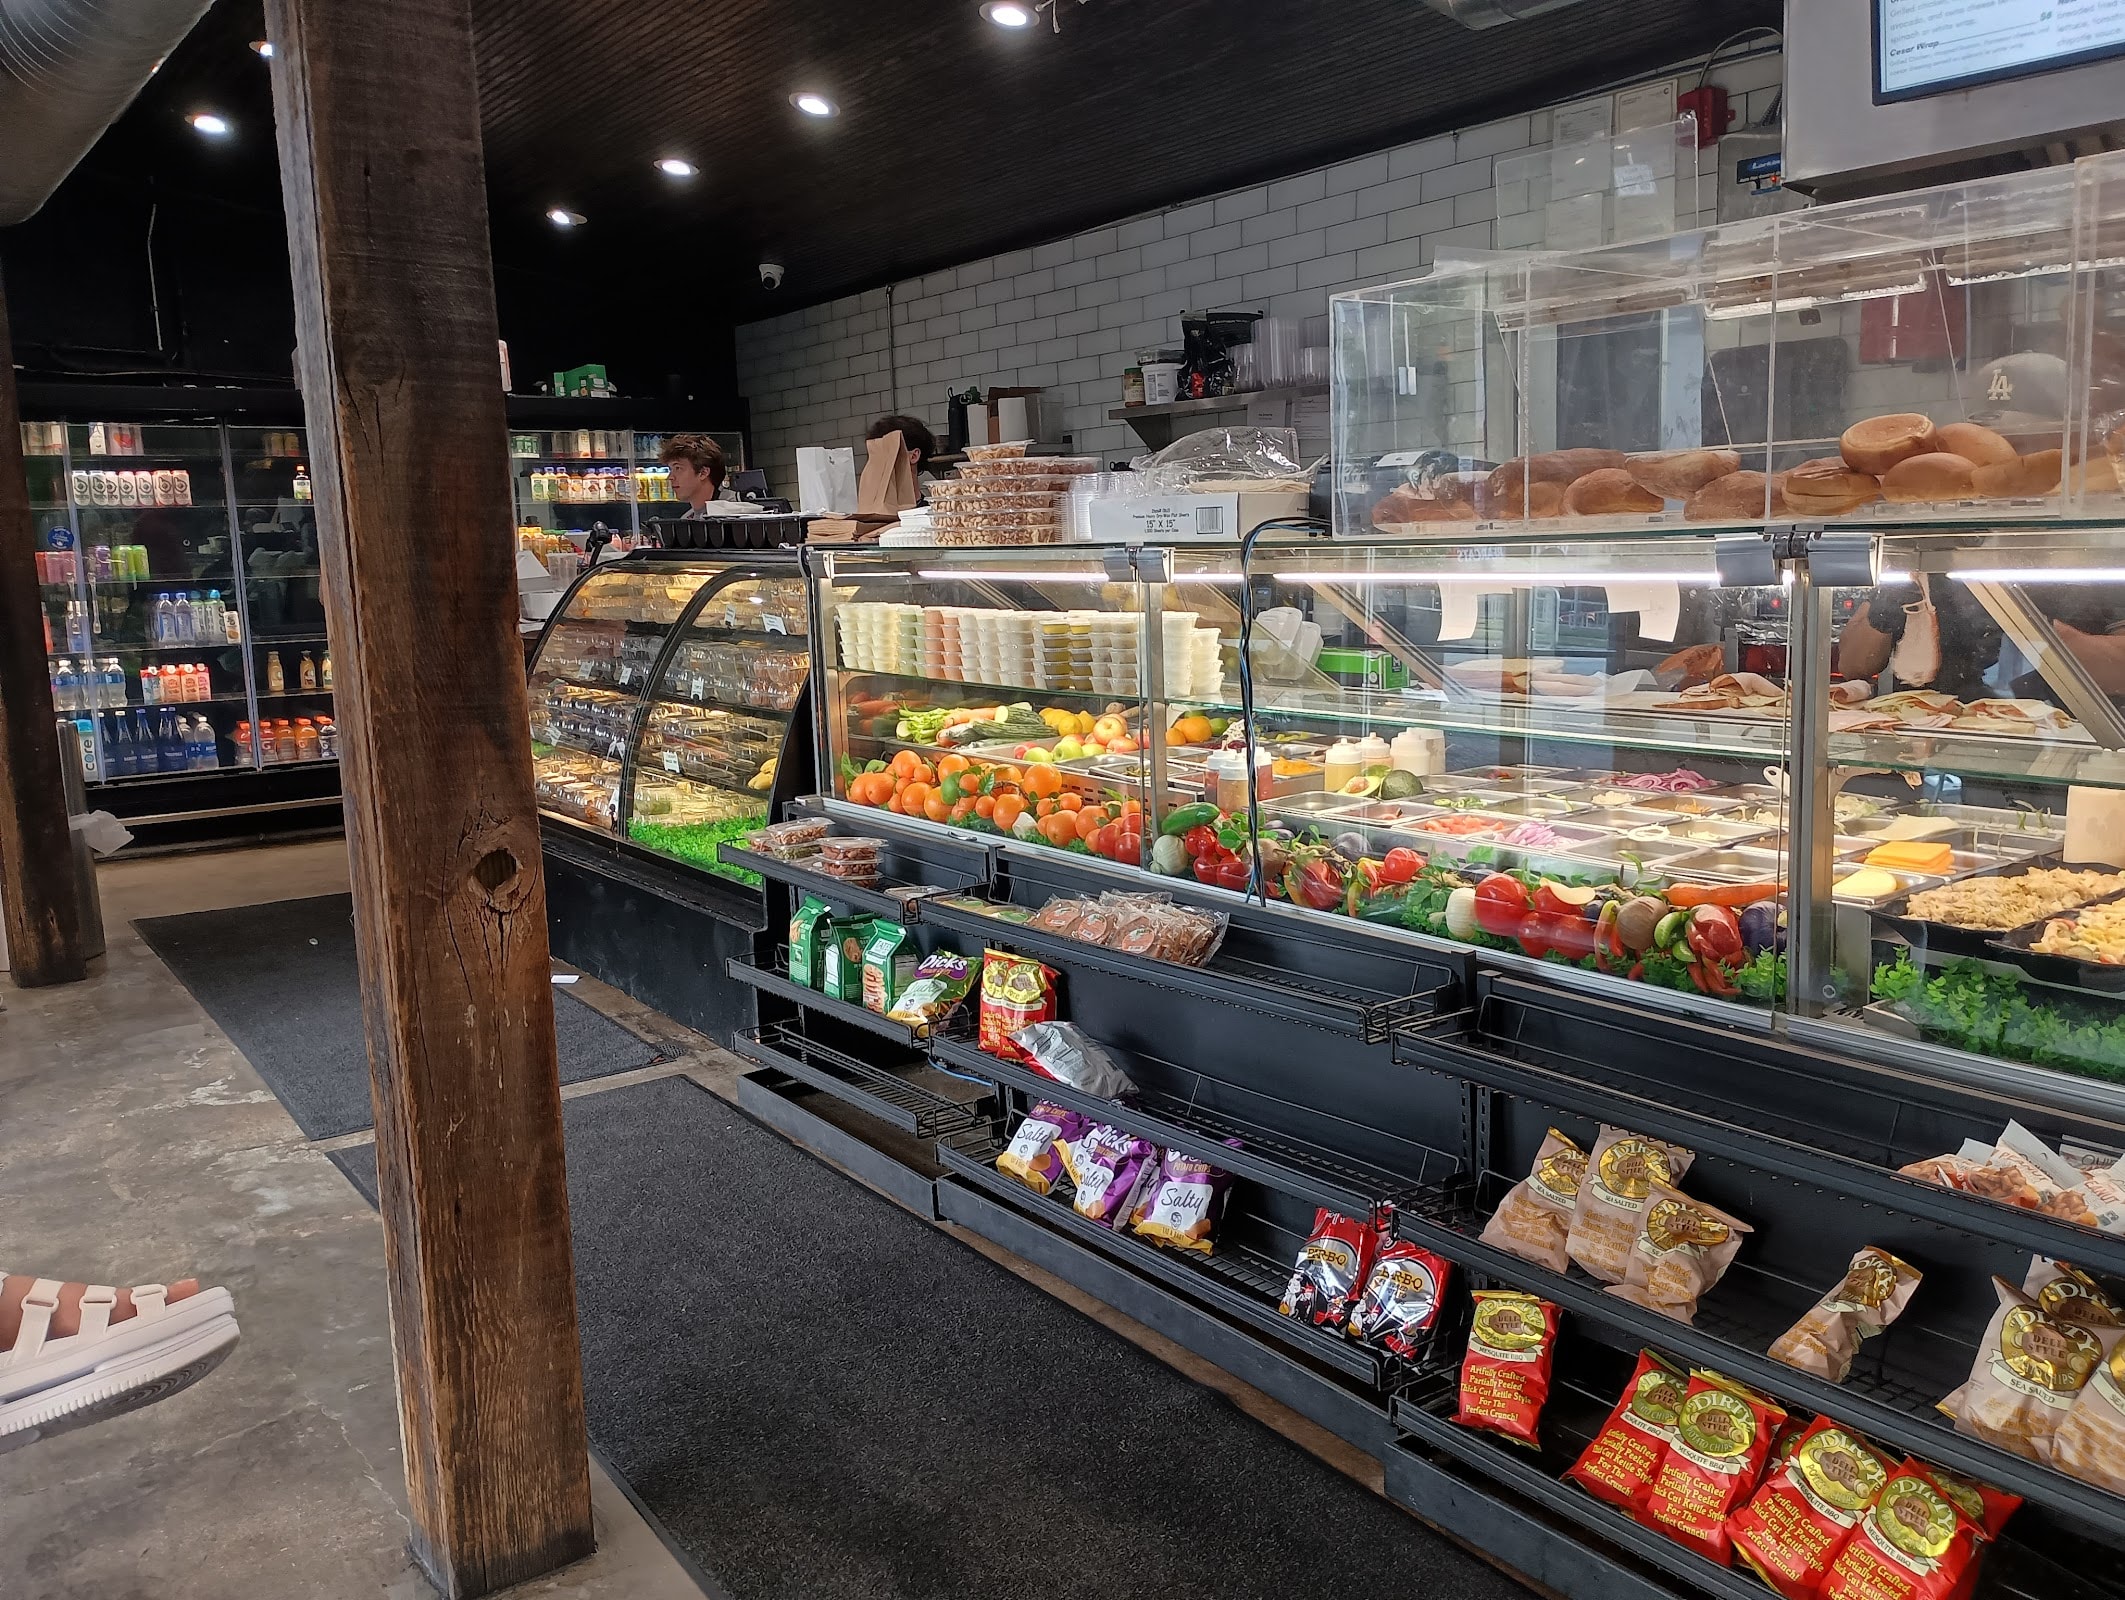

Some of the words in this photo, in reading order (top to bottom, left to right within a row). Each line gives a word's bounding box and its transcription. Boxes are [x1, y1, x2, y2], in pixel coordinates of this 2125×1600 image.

[1890, 46, 1914, 57] Cesar
[1987, 368, 2013, 400] LA
[83, 739, 95, 772] core
[918, 954, 967, 971] Dicks
[1017, 1123, 1051, 1149] Salty
[1172, 1161, 1193, 1172] POTATO
[1194, 1161, 1212, 1173] CHIPS
[1161, 1187, 1204, 1216] Salty
[1545, 1190, 1567, 1205] SALTED
[1614, 1198, 1638, 1210] SALTED
[1479, 1346, 1510, 1359] MESQUITE
[2027, 1343, 2066, 1360] STYLE
[1469, 1375, 1498, 1389] Partially
[1470, 1365, 1497, 1378] Artfully
[1498, 1370, 1527, 1385] Crafted,
[1460, 1383, 1478, 1395] Thick
[1478, 1387, 1492, 1397] Cut
[1492, 1388, 1512, 1400] Kettle
[1513, 1392, 1532, 1405] Style
[2010, 1378, 2027, 1391] SEA
[2028, 1386, 2056, 1405] SALTED
[1465, 1404, 1489, 1417] Perfect
[1489, 1410, 1519, 1423] Crunch!
[1478, 1397, 1492, 1406] For
[1493, 1400, 1506, 1409] The
[1650, 1411, 1675, 1422] CHIPS
[1702, 1422, 1729, 1432] STYLE
[1707, 1413, 1728, 1422] DELI
[1647, 1426, 1661, 1436] BBQ
[1686, 1426, 1709, 1450] POTATO
[1709, 1442, 1734, 1452] CHIPS
[1624, 1446, 1651, 1472] Peeled,
[1628, 1437, 1658, 1463] Crafted,
[1678, 1445, 1709, 1466] MESQUITE
[1708, 1460, 1725, 1471] BBQ
[1597, 1457, 1612, 1471] For
[1612, 1465, 1627, 1480] The
[1602, 1446, 1615, 1460] Cut
[1613, 1453, 1636, 1473] Kettle
[1635, 1468, 1655, 1486] Style
[1663, 1464, 1692, 1485] Artfully
[1832, 1457, 1856, 1473] DELI
[1582, 1461, 1606, 1480] Perfect
[1605, 1475, 1635, 1498] Crunch!
[1660, 1475, 1692, 1497] Partially
[1805, 1464, 1830, 1495] POTATO
[1667, 1491, 1683, 1504] Cut
[1682, 1497, 1707, 1516] Kettle
[1707, 1508, 1726, 1523] Style
[1795, 1478, 1825, 1511] MESQUITE
[1824, 1508, 1840, 1521] BBQ
[1905, 1501, 1927, 1517] DELI
[1666, 1503, 1682, 1517] For
[1682, 1510, 1698, 1524] The
[1772, 1492, 1802, 1522] Artfully
[1800, 1518, 1832, 1549] Crafted,
[1899, 1507, 1926, 1527] STYLE
[1653, 1509, 1677, 1528] Perfect
[1677, 1521, 1708, 1541] Crunch!
[1764, 1498, 1796, 1532] Partially
[1794, 1527, 1823, 1558] Peeled,
[1751, 1501, 1770, 1521] Thick
[1767, 1518, 1783, 1534] Cut
[1780, 1530, 1806, 1556] Kettle
[1803, 1552, 1824, 1572] Style
[1761, 1528, 1777, 1545] For
[1776, 1541, 1792, 1560] The
[1867, 1526, 1896, 1557] MESQUITE
[1896, 1554, 1912, 1567] BBQ
[1743, 1525, 1770, 1554] Perfect
[1768, 1550, 1801, 1582] Crunch!
[1841, 1552, 1873, 1583] Partially
[1846, 1571, 1861, 1588] Cut
[1842, 1583, 1859, 1600] For
